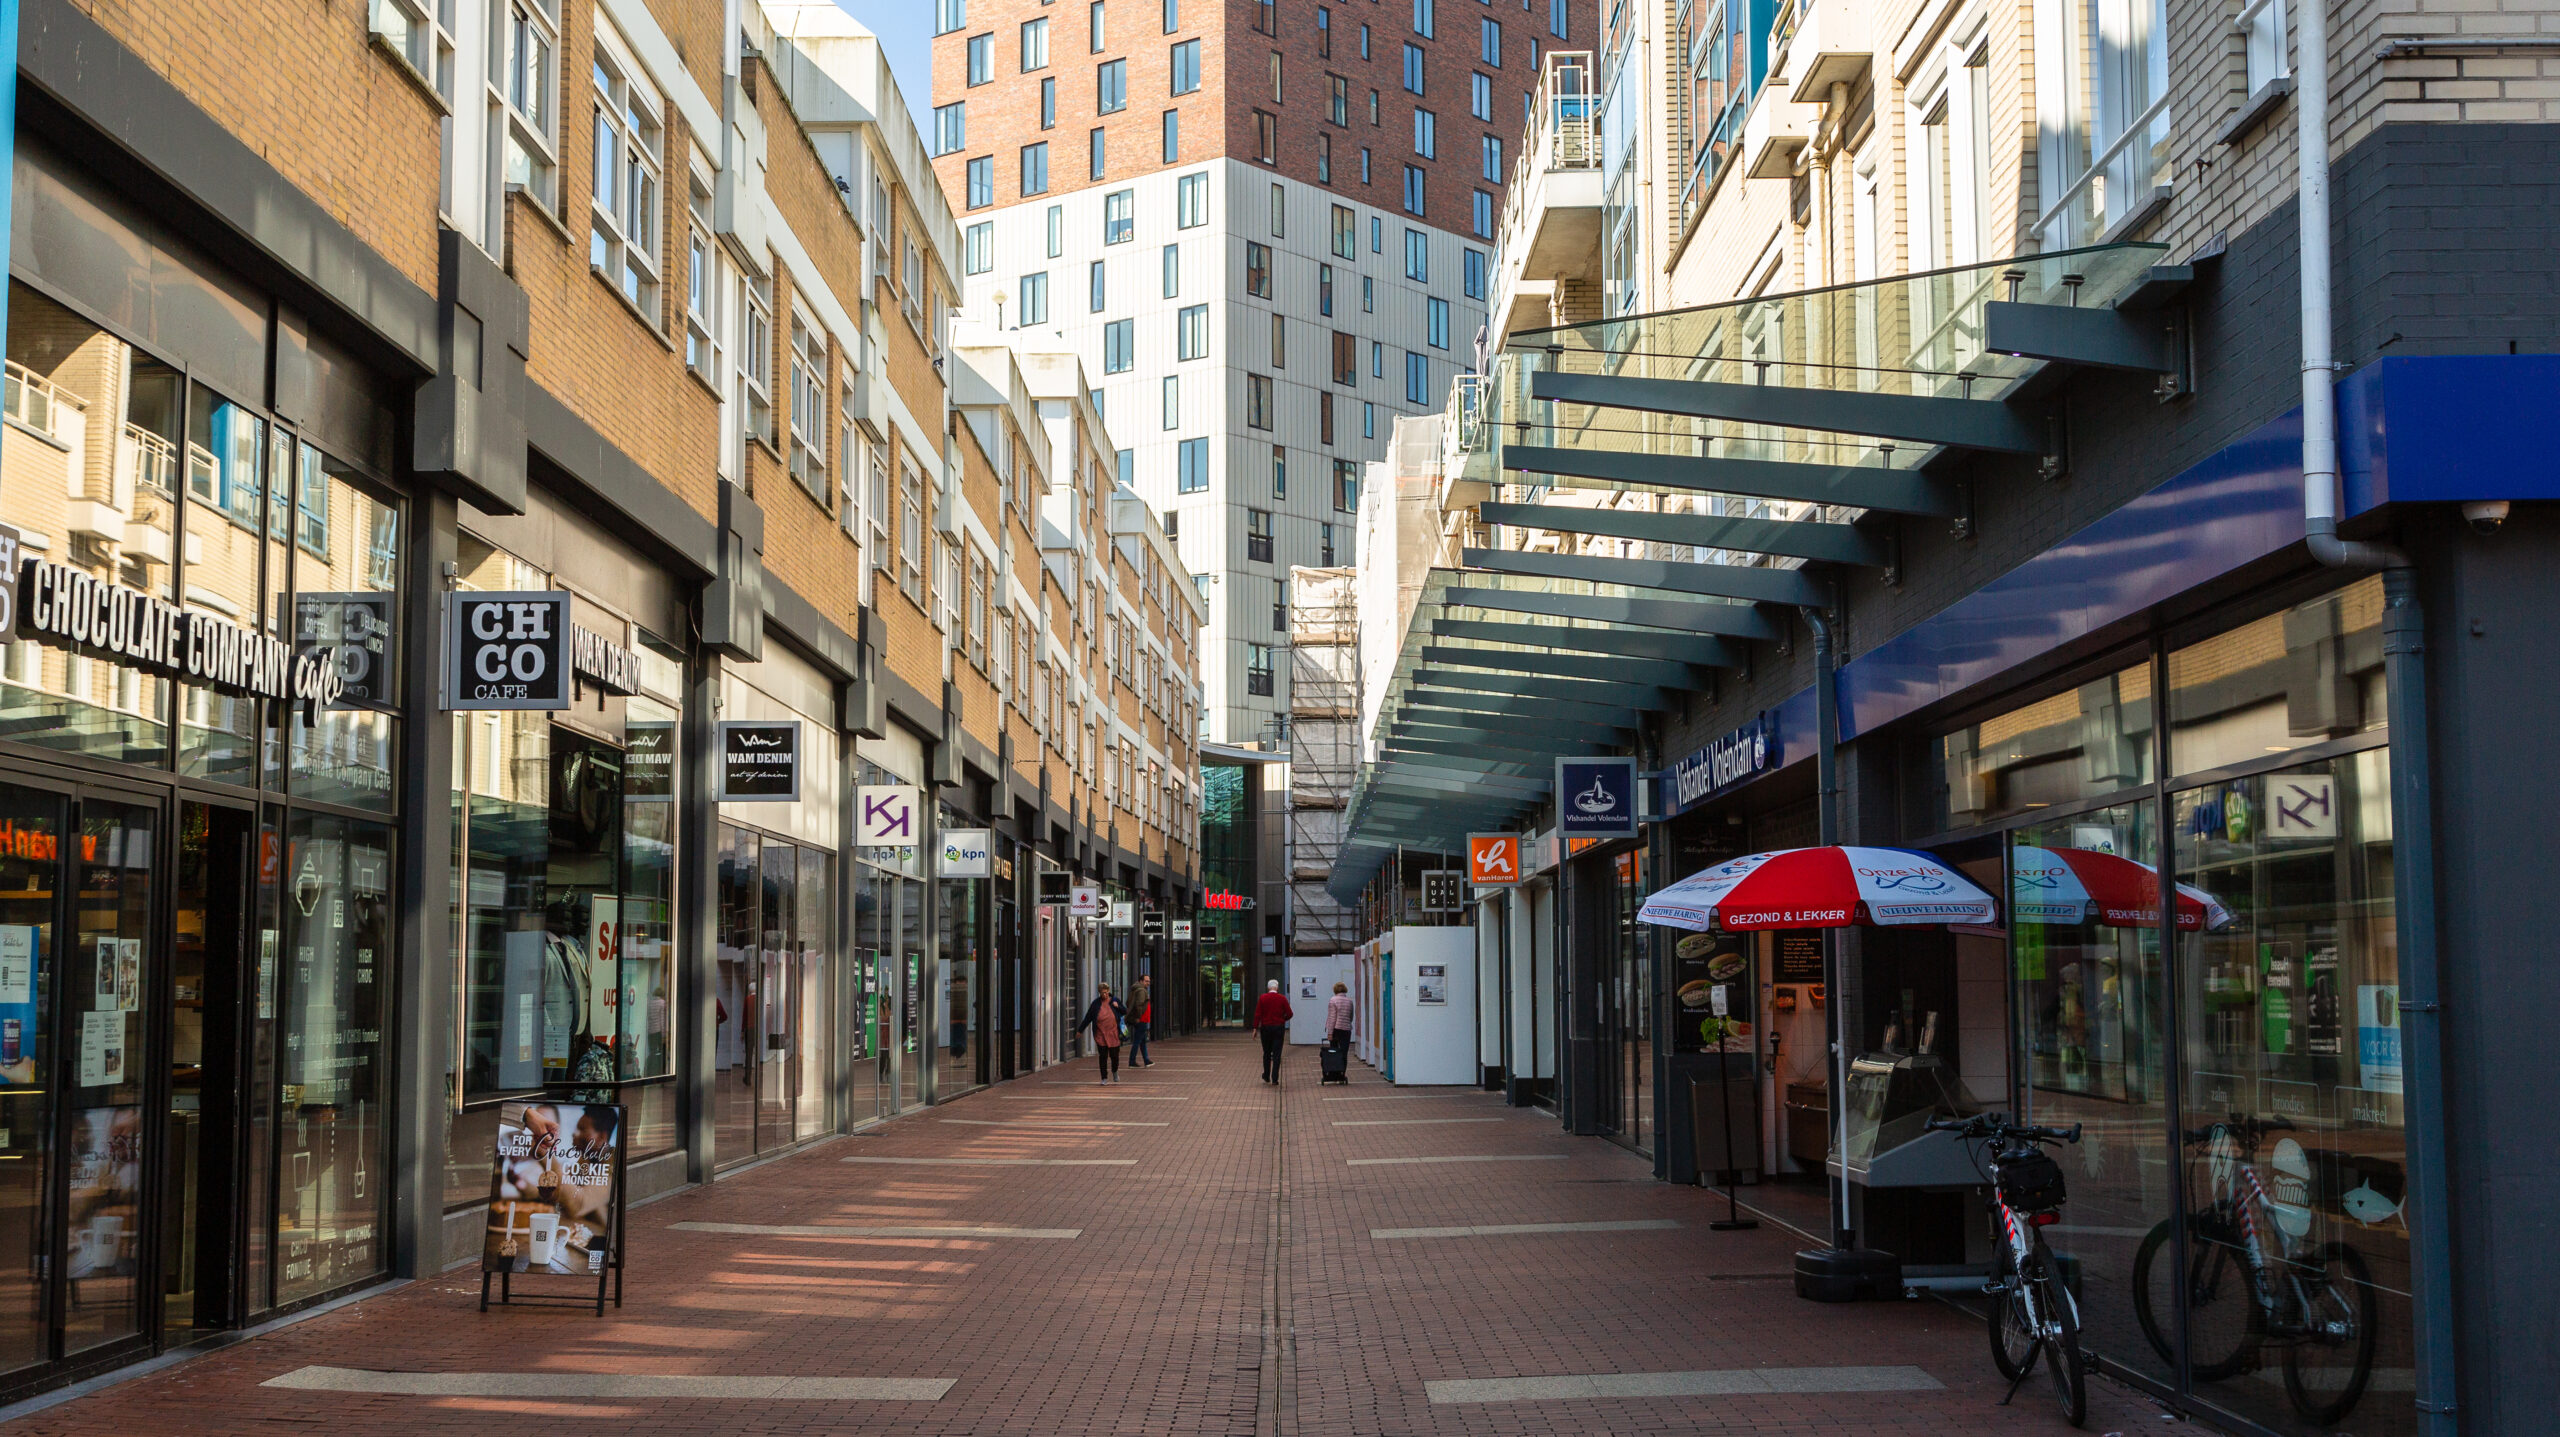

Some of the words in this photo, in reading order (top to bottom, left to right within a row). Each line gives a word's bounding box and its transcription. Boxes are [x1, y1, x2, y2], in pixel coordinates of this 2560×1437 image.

[305, 617, 328, 639] COFFEE
[360, 613, 389, 637] DELICIOUS
[471, 603, 551, 641] CH
[33, 558, 182, 669] CHOCOLATE
[188, 613, 290, 699] COMPANY
[294, 646, 344, 728] café
[365, 635, 384, 655] LUNCH
[475, 644, 546, 682] CO
[573, 623, 606, 681] WAM
[606, 643, 642, 697] DENIM
[474, 685, 528, 700] CAFE
[727, 752, 755, 764] WAM
[756, 752, 793, 764] DENIM
[337, 759, 373, 791] Company
[1676, 747, 1711, 807] Vishandel
[1711, 728, 1752, 790] Volendam
[1566, 814, 1597, 822] Vishandel
[1597, 814, 1629, 822] Volendam
[962, 848, 985, 861] kpn
[1858, 866, 1907, 877] Onze
[1910, 866, 1944, 877] Vis
[1205, 887, 1243, 911] Locker
[1644, 906, 1674, 917] NIEUWE
[1673, 909, 1704, 922] HARING
[1729, 911, 1781, 925] GEZOND
[1783, 912, 1793, 922] &
[1795, 910, 1846, 921] LEKKER
[1881, 906, 1933, 916] NIEUWE
[1934, 905, 1985, 915] HARING
[1143, 919, 1163, 928] Amac
[299, 946, 314, 962] HIGH
[358, 948, 373, 964] HIGH
[300, 968, 313, 983] TEA
[357, 968, 373, 984] CHOC
[2211, 1088, 2228, 1103] zalm
[2272, 1095, 2305, 1114] broodjes
[2352, 1103, 2388, 1124] makreel
[500, 1146, 532, 1157] EVERY
[534, 1131, 612, 1162] Chocolate
[512, 1134, 533, 1146] FOR
[562, 1162, 610, 1177] COOKIE
[561, 1176, 609, 1187] MONSTER
[345, 1223, 372, 1245] HOTCHOC
[348, 1244, 368, 1265] SPOON
[286, 1258, 311, 1281] FONDUE
